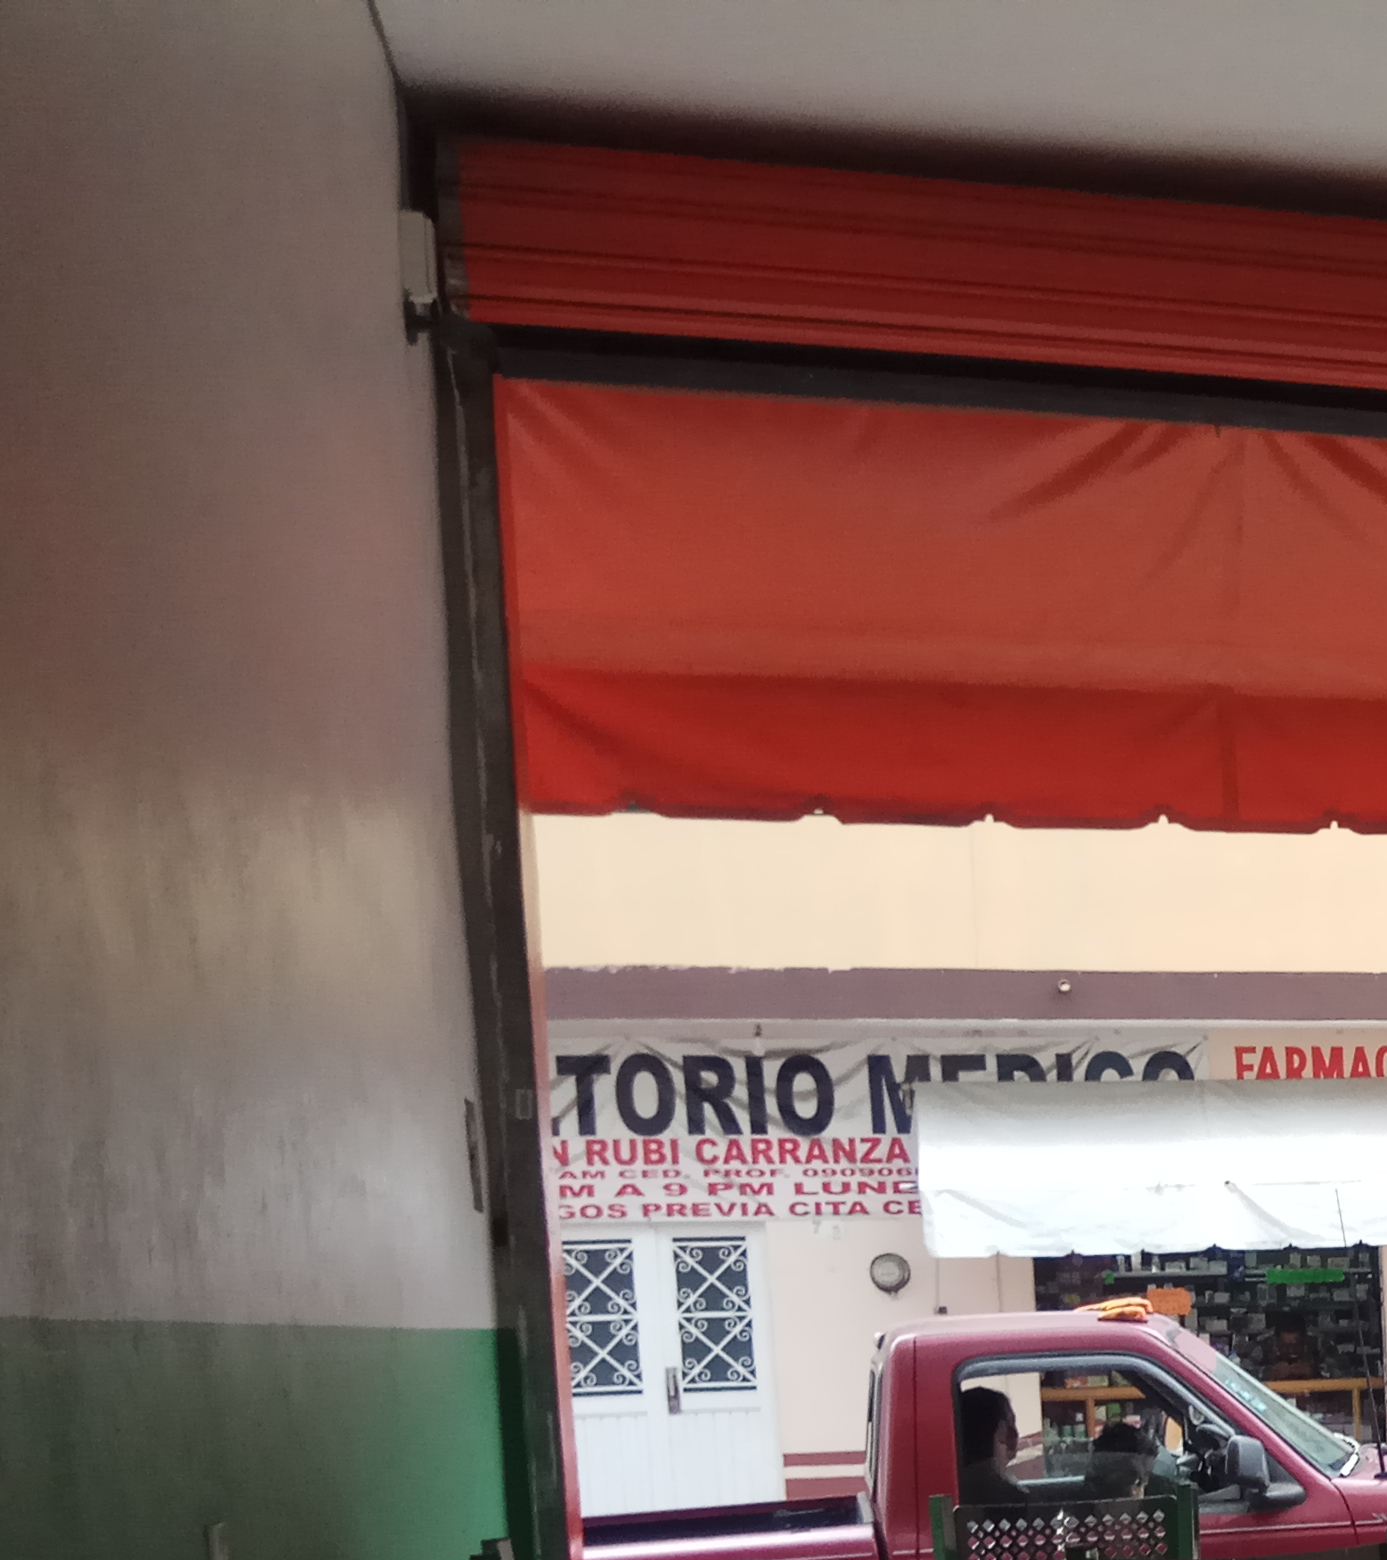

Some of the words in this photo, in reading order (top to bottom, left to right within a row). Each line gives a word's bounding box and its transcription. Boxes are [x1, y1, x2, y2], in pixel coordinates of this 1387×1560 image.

[552, 1052, 834, 1136] TORIO
[585, 1138, 680, 1166] RUBI
[695, 1137, 911, 1165] CARRANZA
[614, 1184, 645, 1198] A
[662, 1182, 688, 1197] 9
[707, 1181, 775, 1197] PM
[641, 1202, 775, 1218] PREVIA
[788, 1201, 870, 1216] CITA
